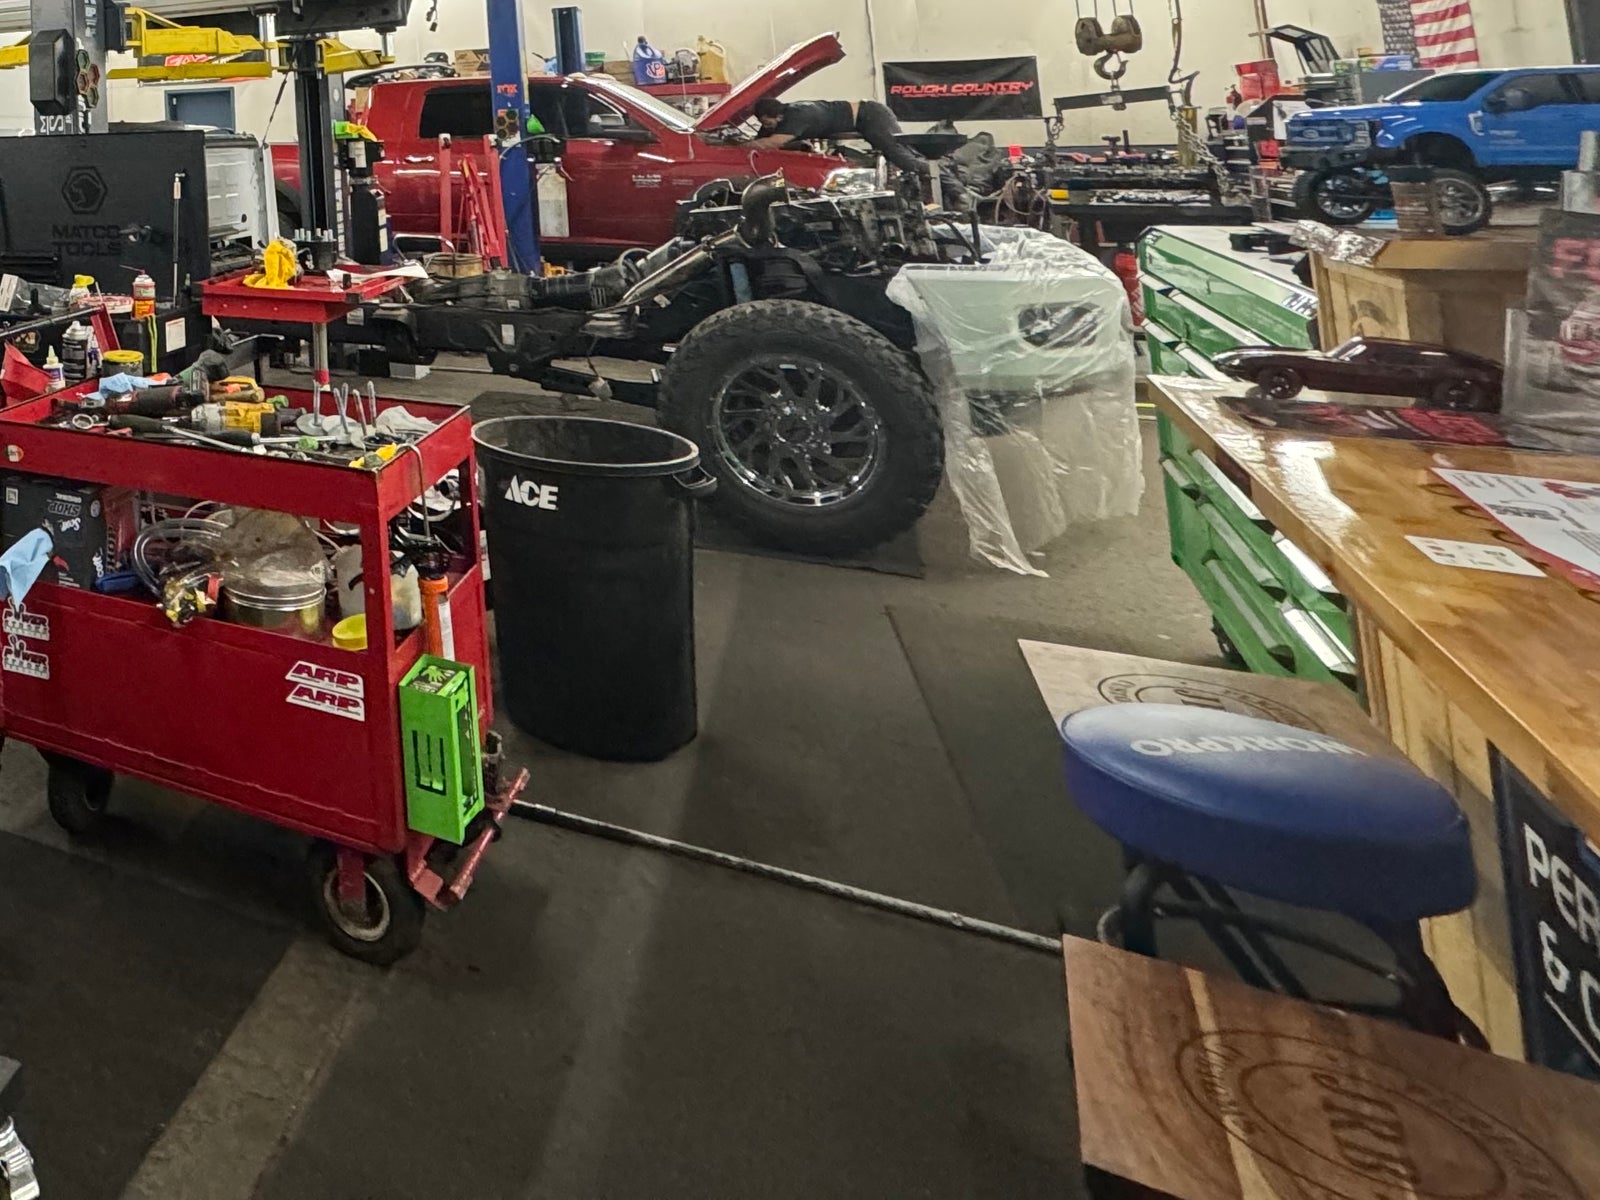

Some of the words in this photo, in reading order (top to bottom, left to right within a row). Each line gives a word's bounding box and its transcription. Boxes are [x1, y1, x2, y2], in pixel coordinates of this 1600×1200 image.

[890, 84, 948, 95] ROUGH
[951, 81, 1035, 93] COUNTRY
[52, 224, 121, 239] MATCO
[51, 241, 122, 256] TOOLS
[504, 474, 559, 511] ACE
[291, 663, 360, 686] ARP
[292, 686, 361, 709] ARP
